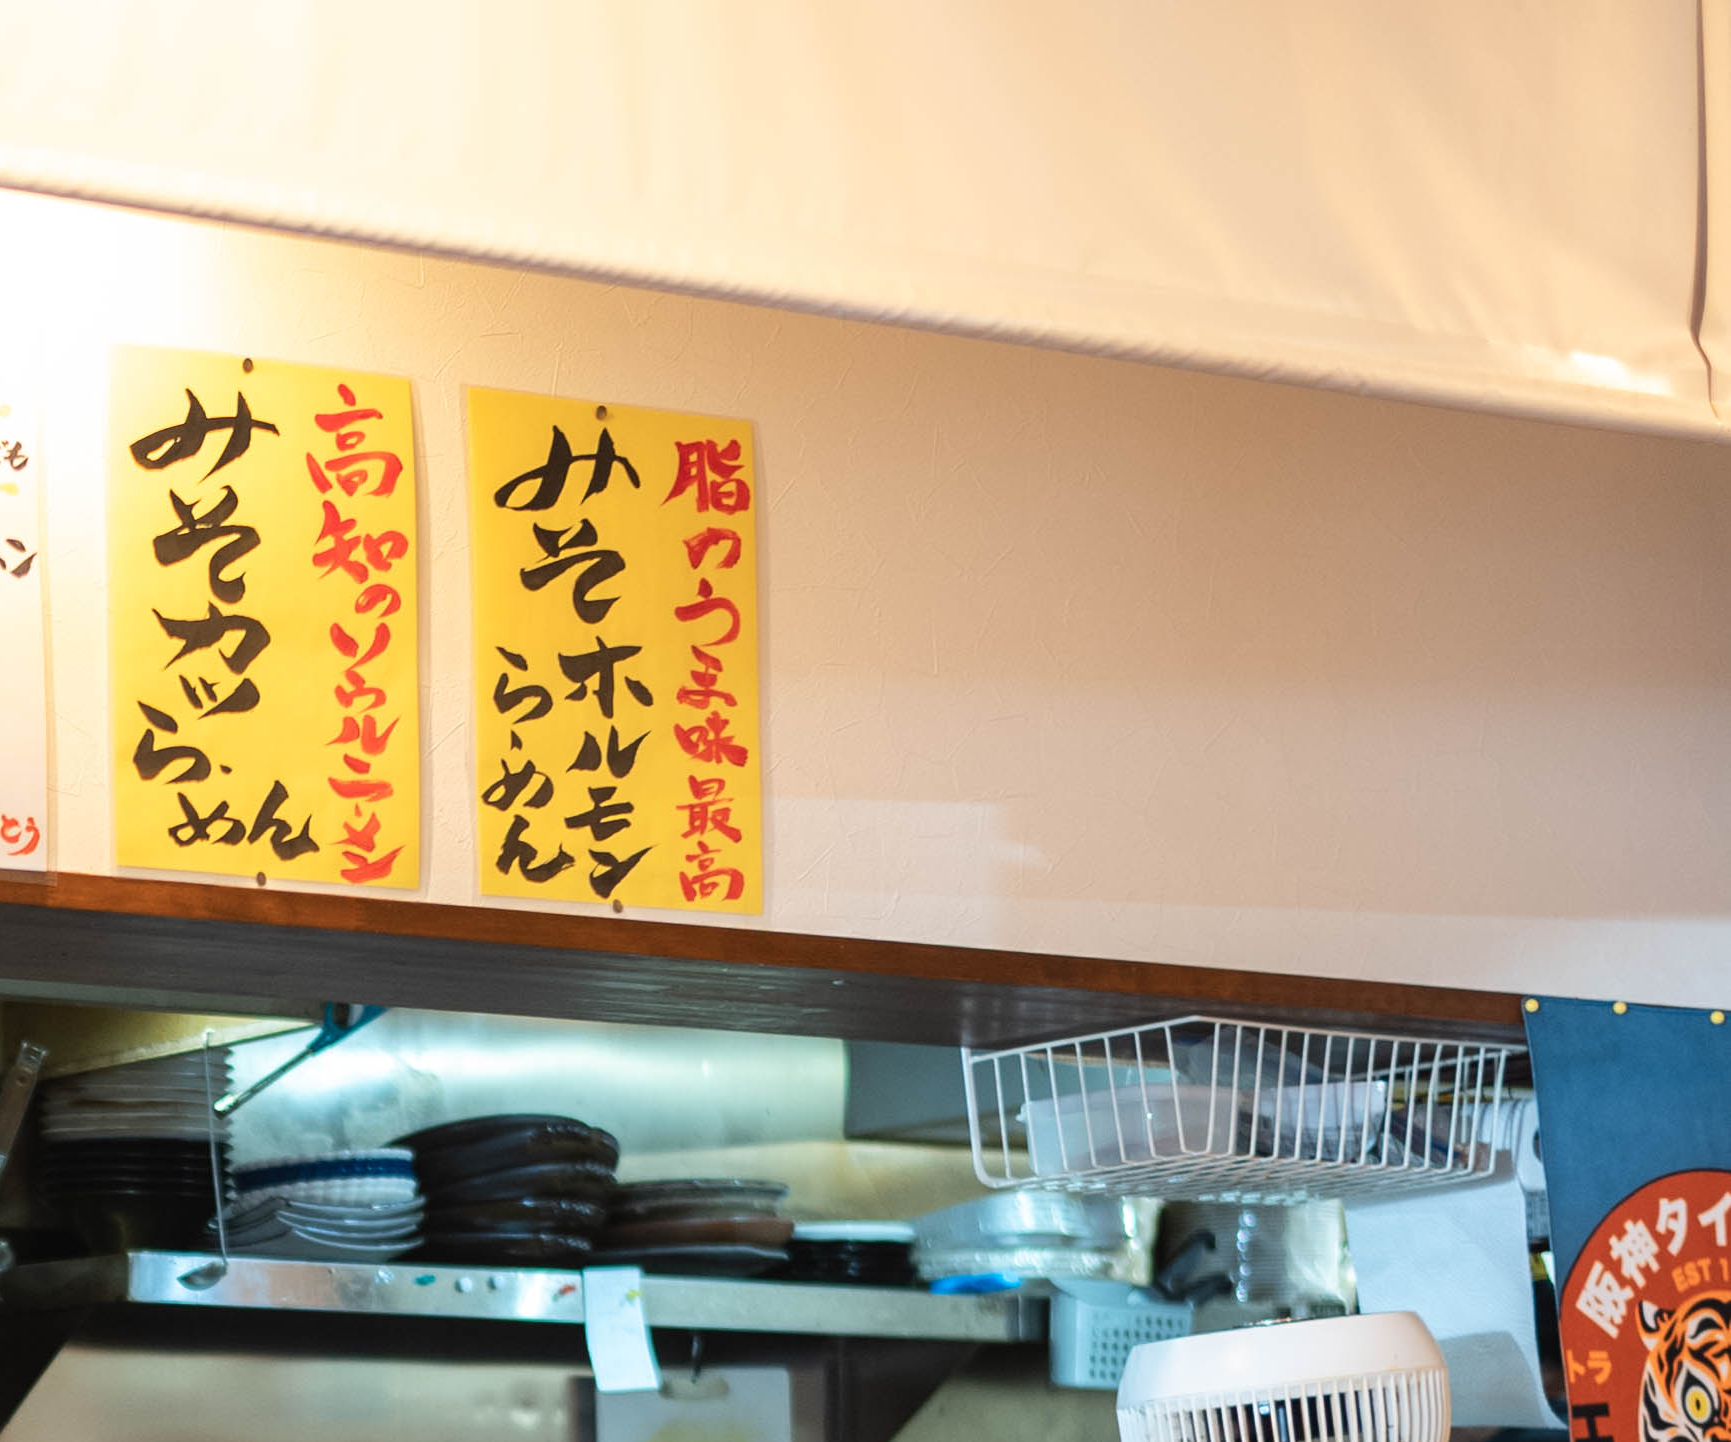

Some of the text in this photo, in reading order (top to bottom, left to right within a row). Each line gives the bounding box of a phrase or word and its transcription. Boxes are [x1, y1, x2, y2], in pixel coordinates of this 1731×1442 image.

[659, 438, 752, 903] 脂のうま味最高
[1672, 1257, 1711, 1293] EST
